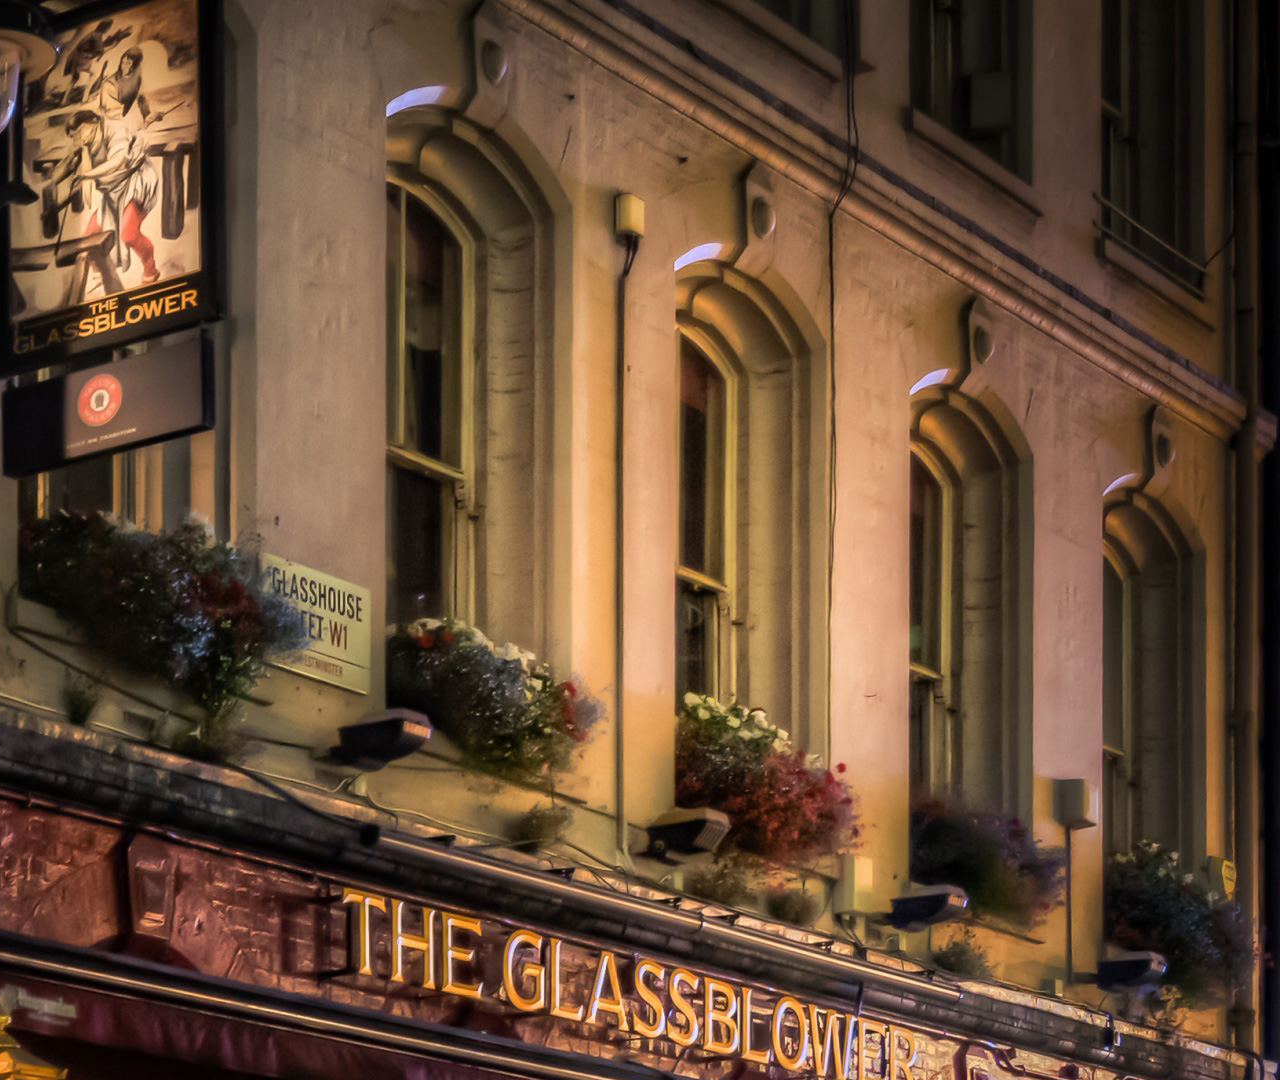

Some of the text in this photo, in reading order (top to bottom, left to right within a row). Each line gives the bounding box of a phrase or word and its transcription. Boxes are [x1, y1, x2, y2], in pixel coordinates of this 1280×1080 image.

[13, 288, 198, 354] GLASSBLOWER
[89, 297, 119, 315] THE
[272, 567, 363, 622] GLASSHOUSE
[329, 619, 348, 650] W1
[304, 654, 343, 678] ESTMINSTER
[343, 888, 483, 999] THE
